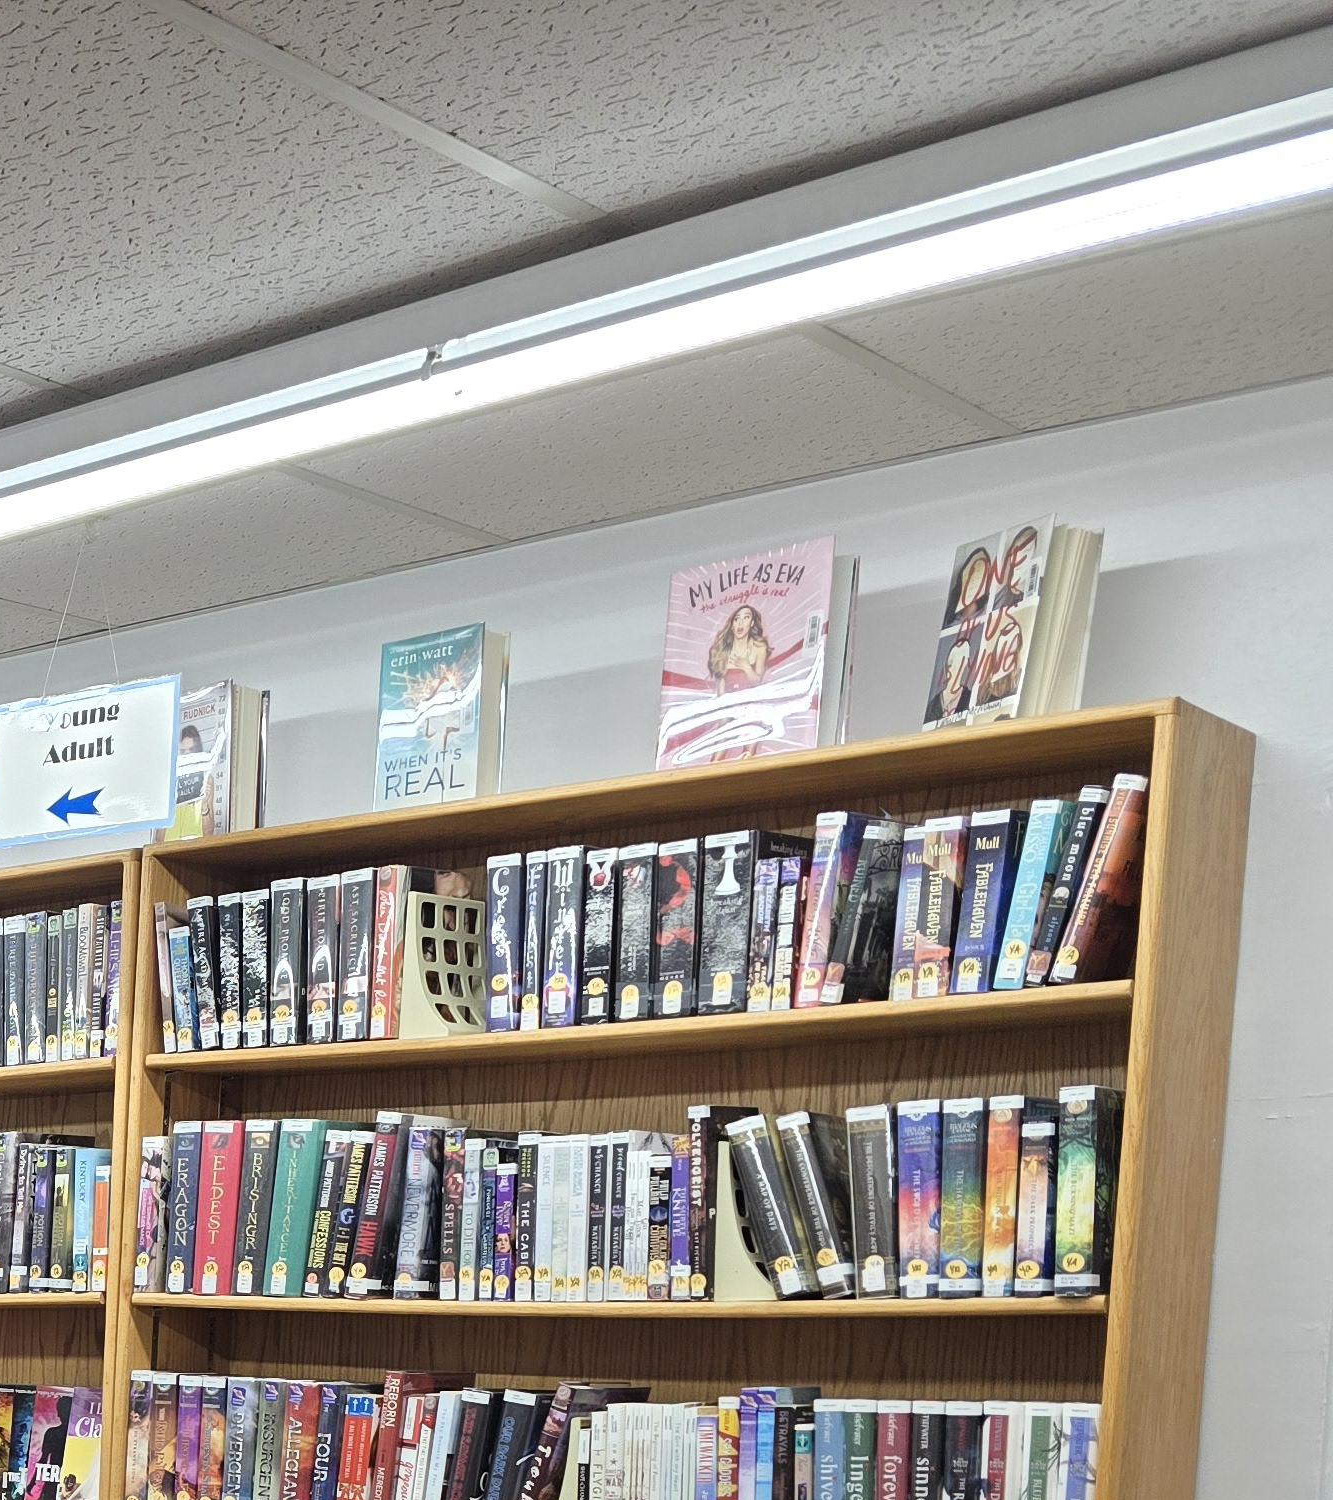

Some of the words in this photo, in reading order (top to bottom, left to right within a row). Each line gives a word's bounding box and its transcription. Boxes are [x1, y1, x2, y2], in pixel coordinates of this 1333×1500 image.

[689, 580, 713, 608] MY
[719, 565, 749, 592] LIFE
[752, 563, 773, 583] AS
[775, 563, 806, 586] EVA
[961, 531, 1038, 608] ONE
[700, 602, 715, 614] the
[719, 584, 759, 608] struggle
[771, 587, 790, 598] real
[984, 603, 1019, 641] US
[390, 651, 417, 668] erin
[422, 645, 453, 659] watt
[183, 703, 216, 721] RUDNICK
[42, 735, 115, 766] Adult
[384, 753, 429, 773] WHEN
[435, 748, 462, 764] IT'S
[385, 764, 465, 800] REAL
[1075, 807, 1095, 838] blue
[929, 843, 952, 857] Mull
[976, 838, 1000, 850] Mull
[1061, 843, 1080, 881] moon
[970, 862, 994, 939] FABLEHAVEN
[373, 1140, 386, 1168] JAMES
[174, 1158, 190, 1245] ERAGON
[206, 1155, 225, 1245] ELDEST
[244, 1152, 264, 1250] BRISINGR
[280, 1149, 299, 1253] INHERITANCE
[364, 1170, 383, 1216] PATTERSON
[354, 1220, 378, 1256] HAWK
[401, 1178, 420, 1257] NEVERMORE
[443, 1203, 455, 1255] SPELLS
[313, 1210, 332, 1269] CONFESSIONS
[387, 1378, 400, 1428] REBORN
[313, 1433, 332, 1482] FOUR
[777, 1410, 788, 1464] BETRAYALS
[494, 1444, 511, 1477] DARK
